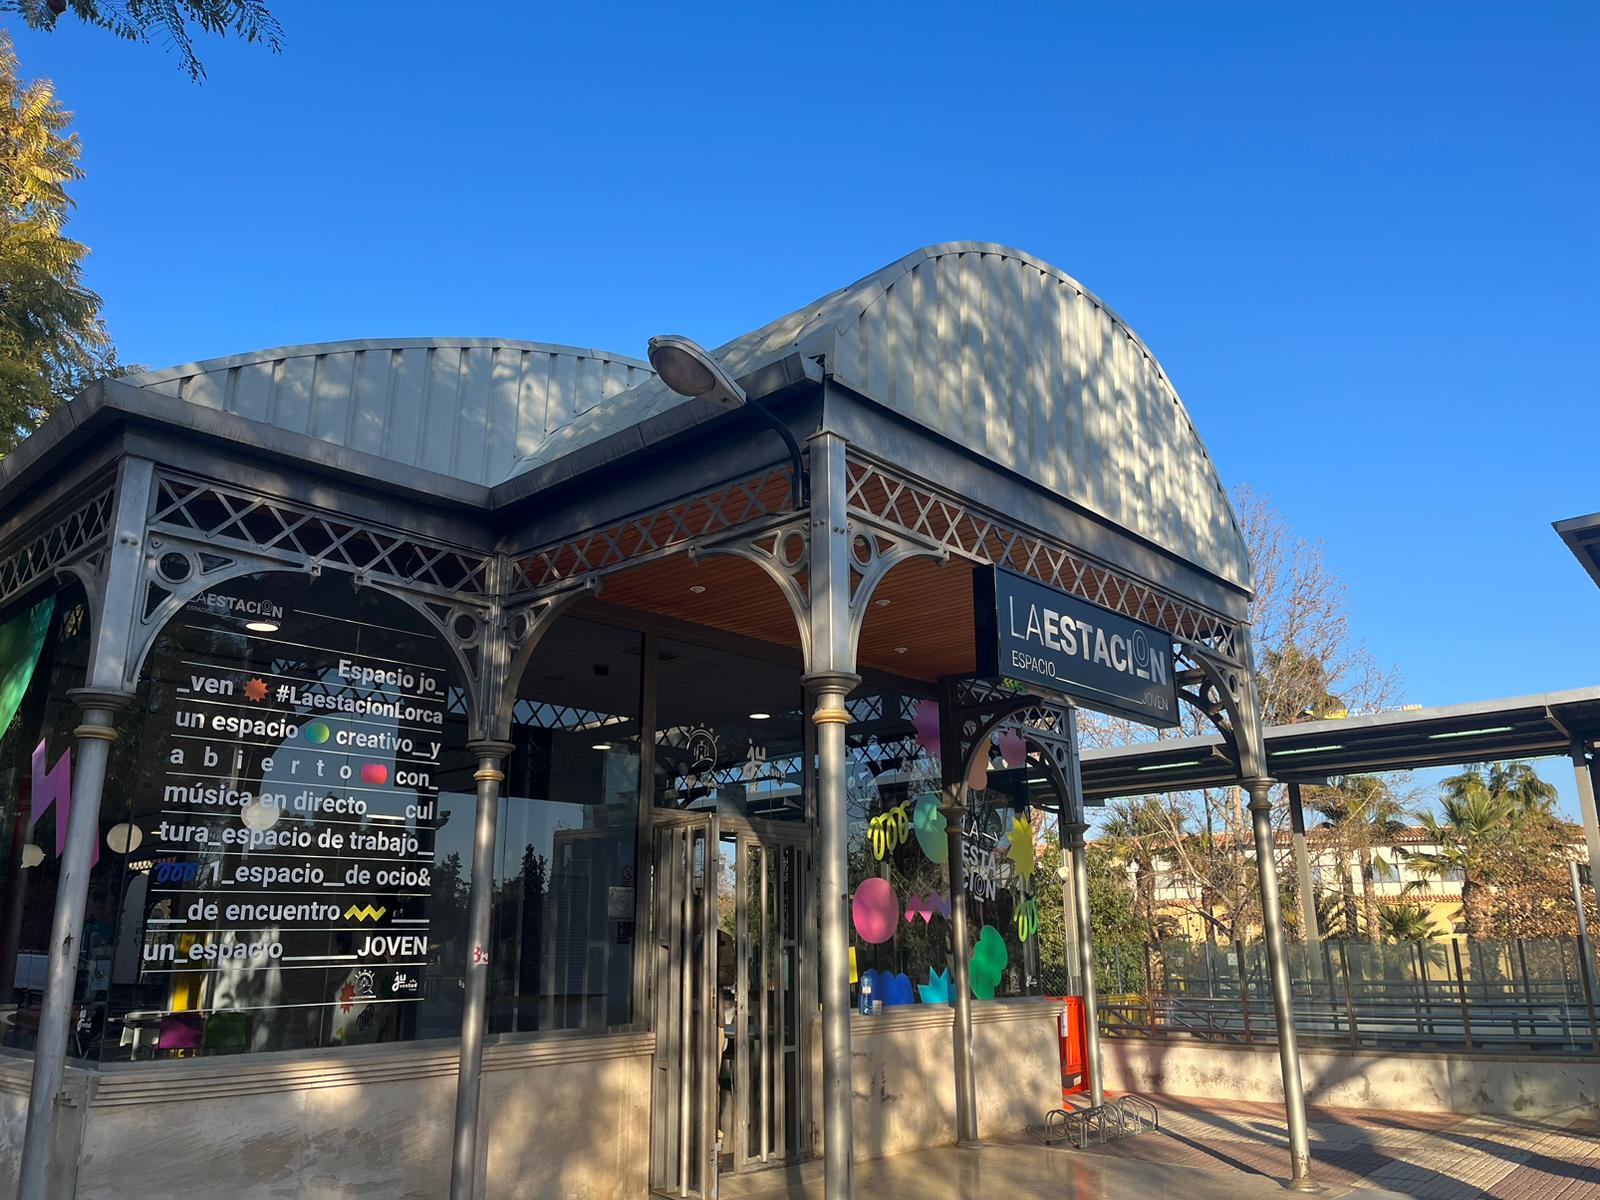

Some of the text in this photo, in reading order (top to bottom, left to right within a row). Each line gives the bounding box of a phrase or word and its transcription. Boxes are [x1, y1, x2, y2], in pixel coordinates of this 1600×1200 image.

[339, 660, 414, 688] Espacio
[1012, 651, 1056, 677] ESPACIO
[276, 685, 443, 725] #LaestacionLorca
[1142, 692, 1169, 711] JOVEN
[176, 709, 204, 729] un
[212, 715, 298, 740] espacio
[164, 782, 252, 806] música
[260, 792, 286, 809] en
[318, 828, 344, 849] de
[376, 866, 431, 887] ocio&
[226, 902, 340, 922] encuentro
